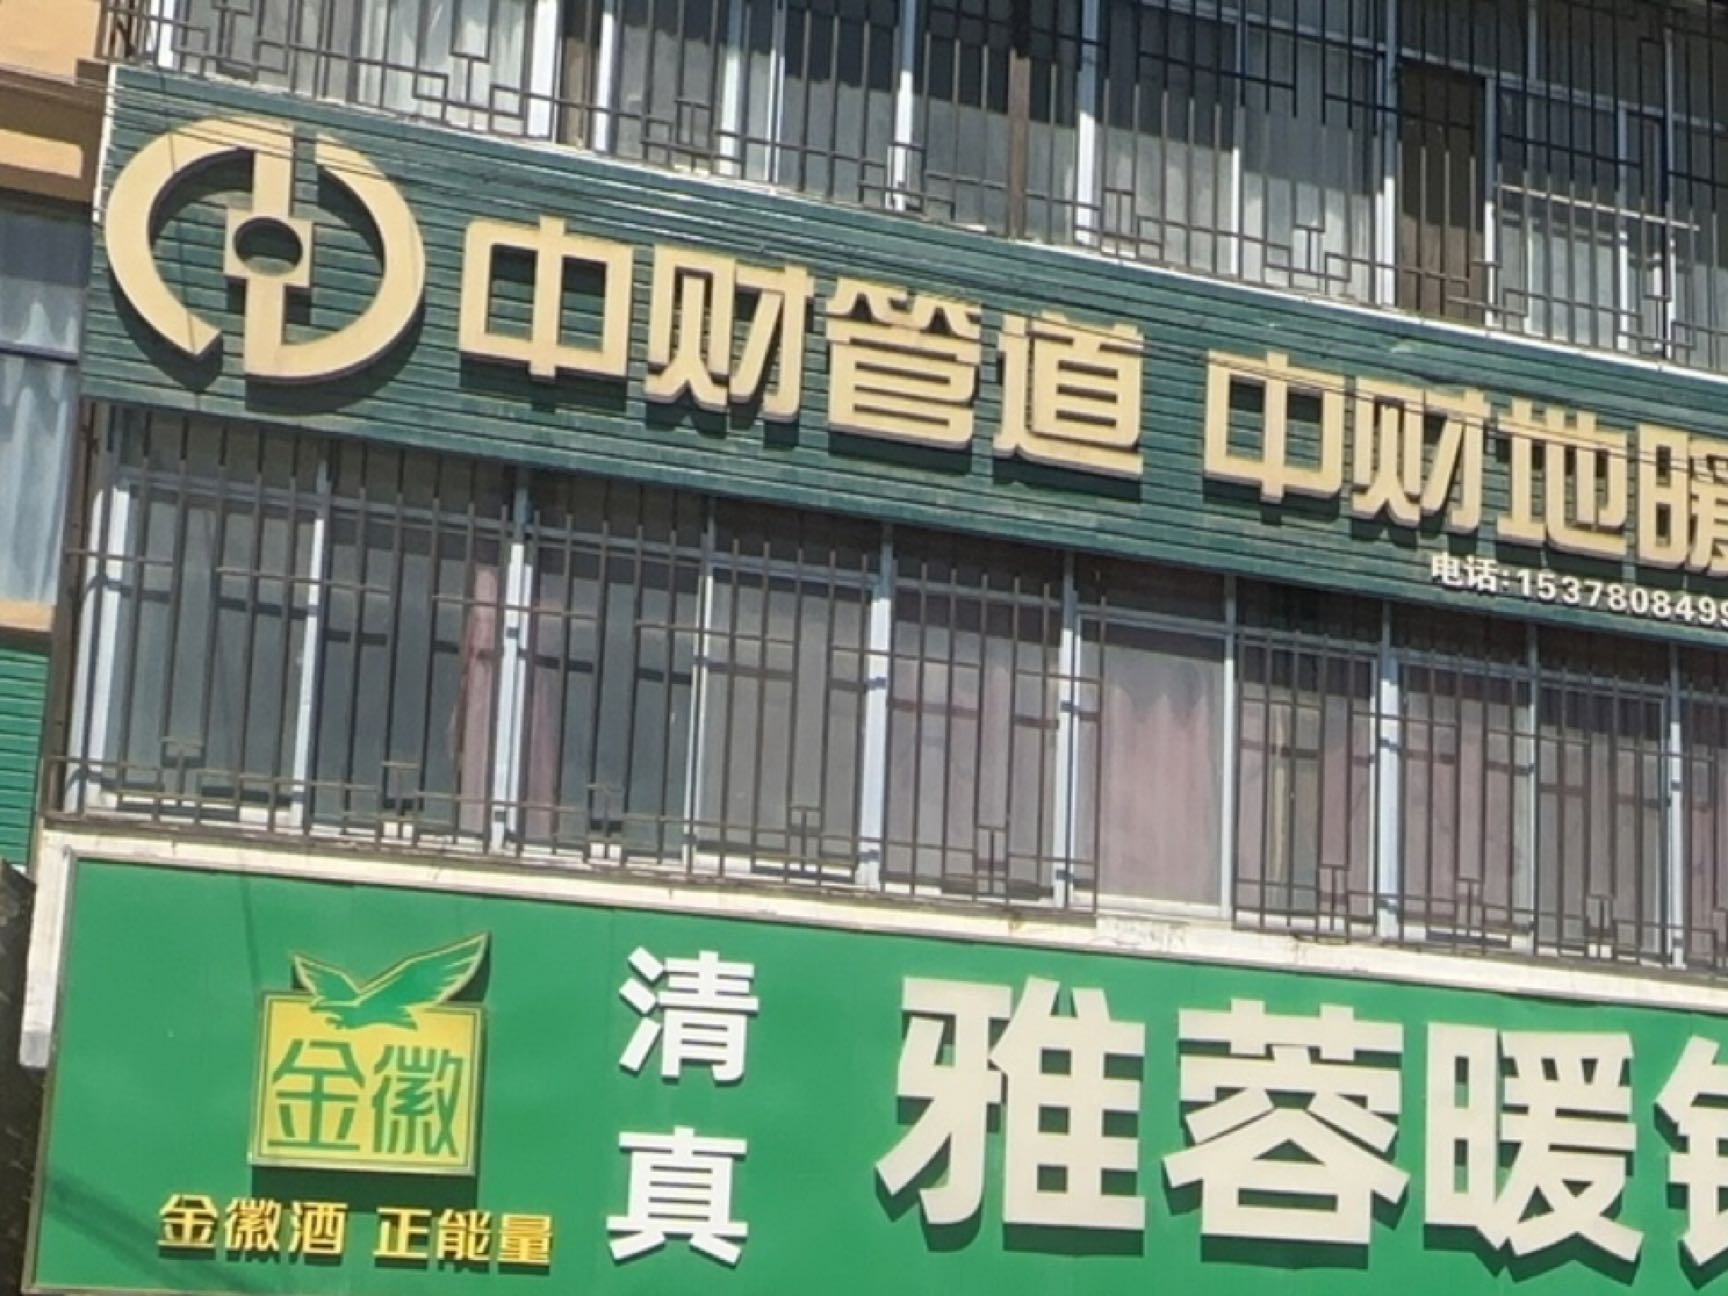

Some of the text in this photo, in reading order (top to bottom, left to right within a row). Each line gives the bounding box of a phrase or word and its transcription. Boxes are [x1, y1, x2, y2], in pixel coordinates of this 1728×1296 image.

[459, 215, 1143, 477] 中财管道
[266, 1038, 466, 1159] 金徽
[606, 945, 760, 1267] 清真
[156, 1193, 556, 1268] 金徽酒 正能量
